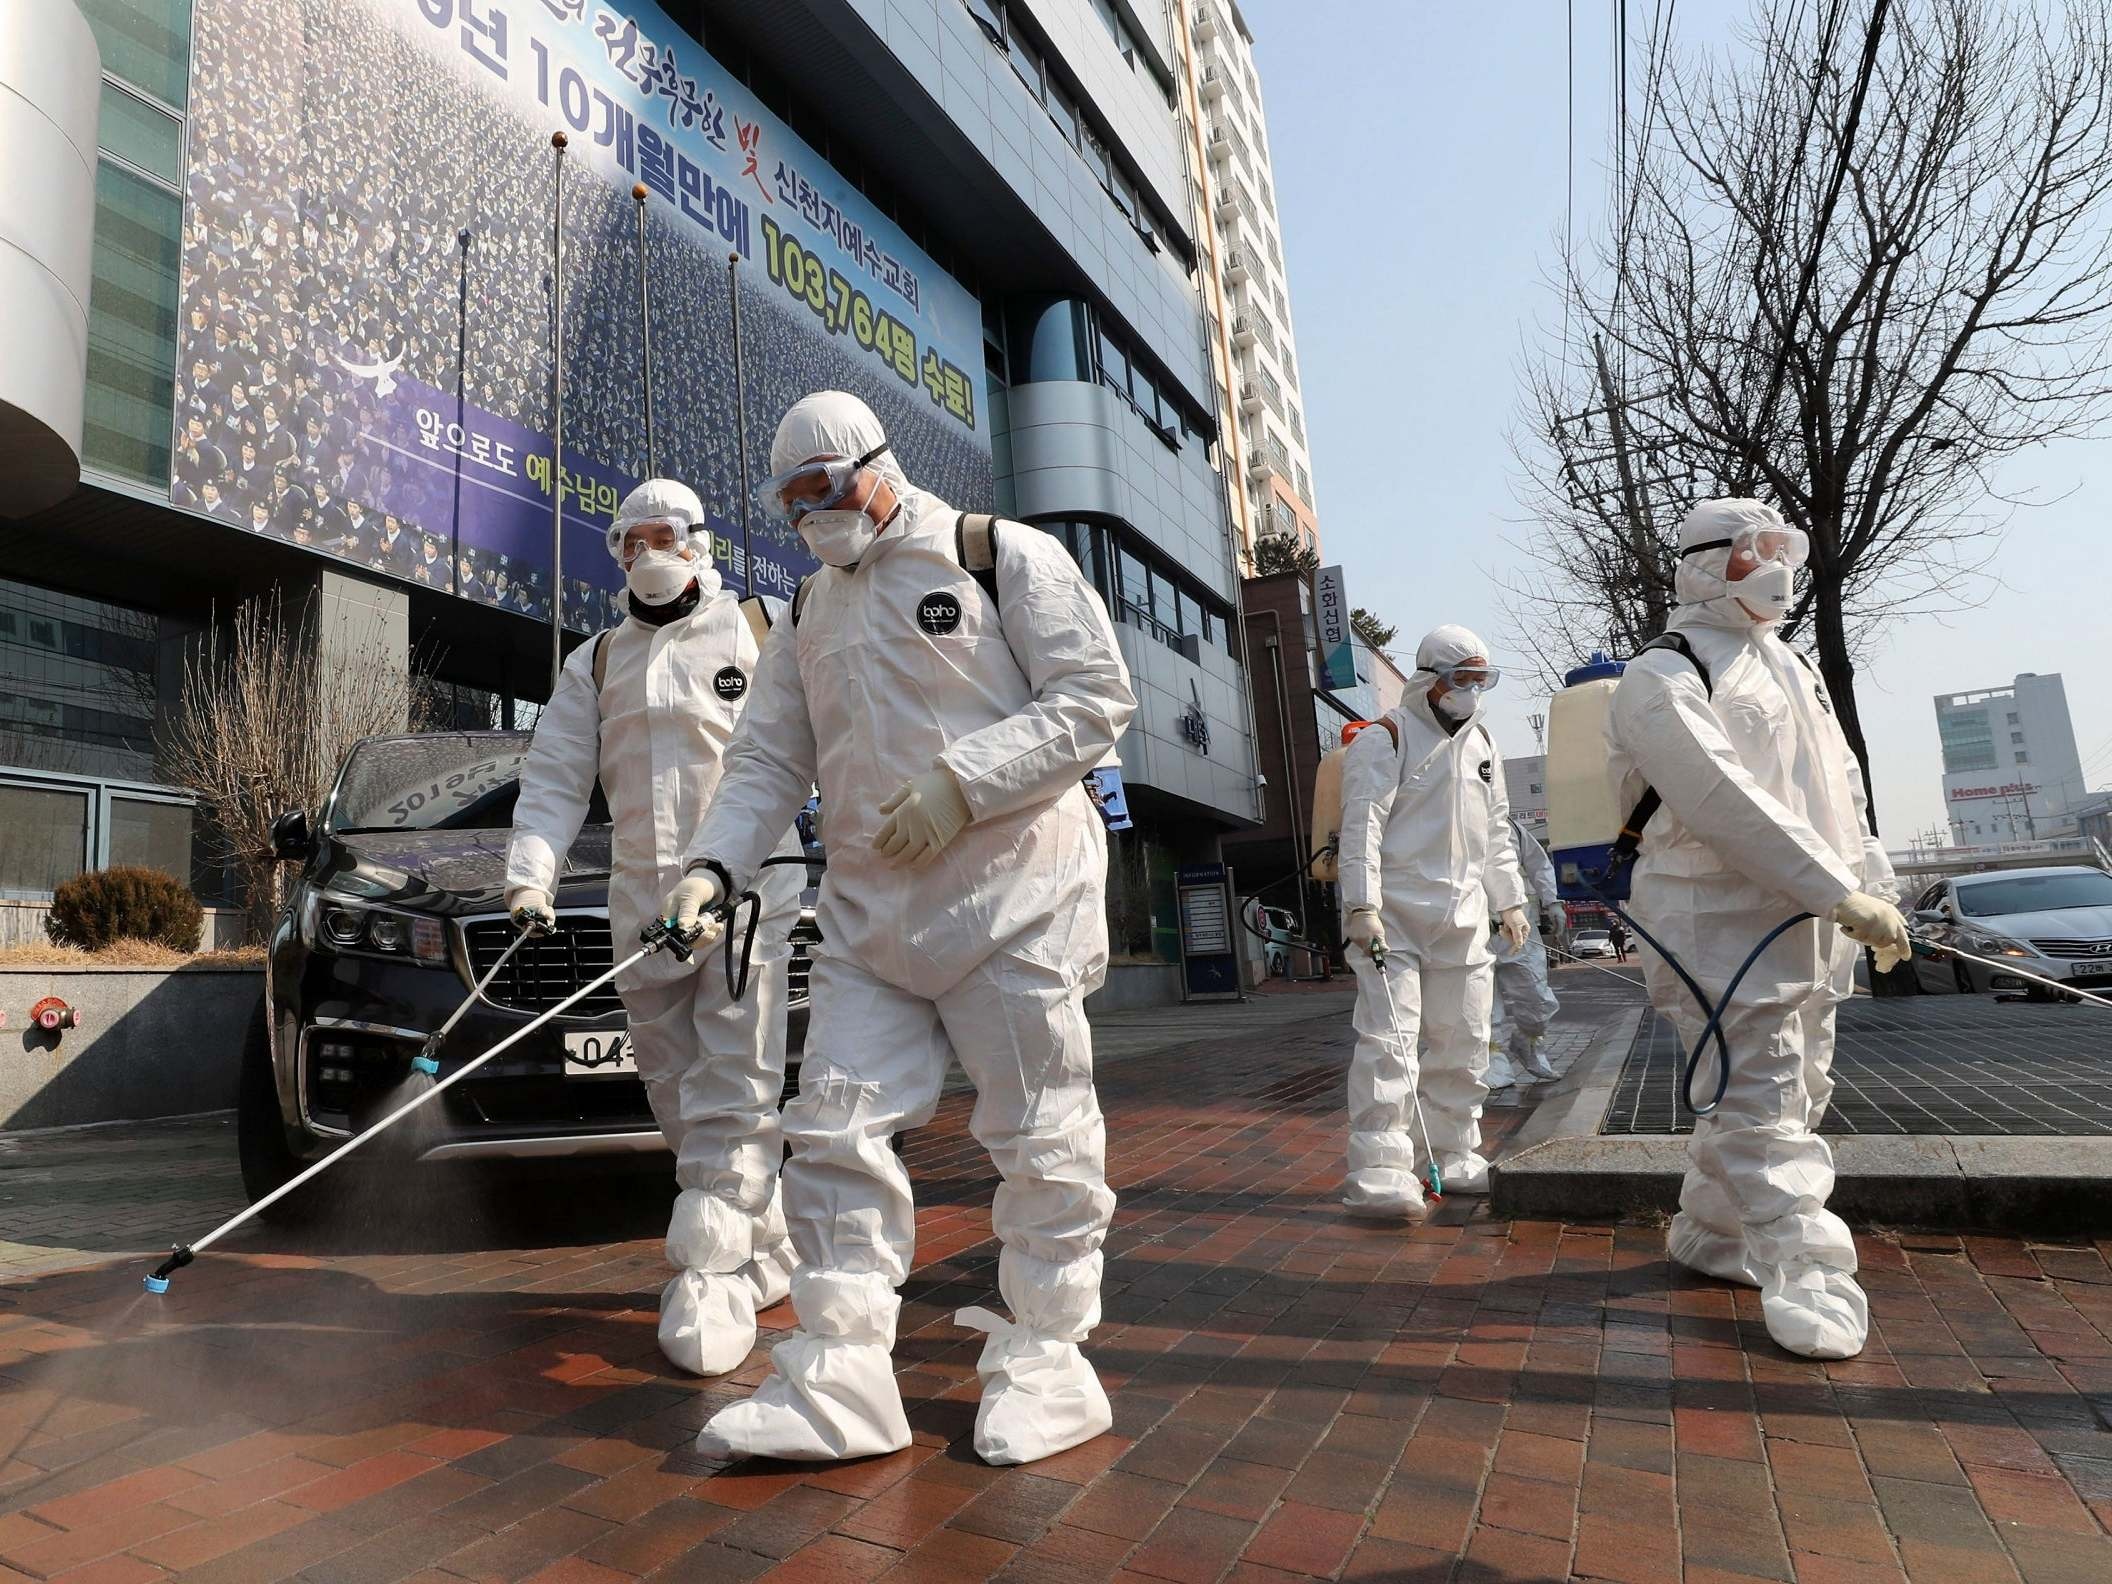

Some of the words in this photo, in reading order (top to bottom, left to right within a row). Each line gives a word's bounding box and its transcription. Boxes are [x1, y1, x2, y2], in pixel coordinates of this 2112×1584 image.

[530, 36, 750, 261] 10개월만에
[761, 213, 918, 388] 103,764명
[923, 347, 975, 431] 수료!
[734, 114, 774, 204] 빛
[774, 161, 920, 314] 신천지예수교회
[416, 408, 518, 477] 앞으로도
[526, 454, 618, 522] 예수님의
[752, 555, 796, 599] 전하는
[1952, 786, 1997, 798] Home
